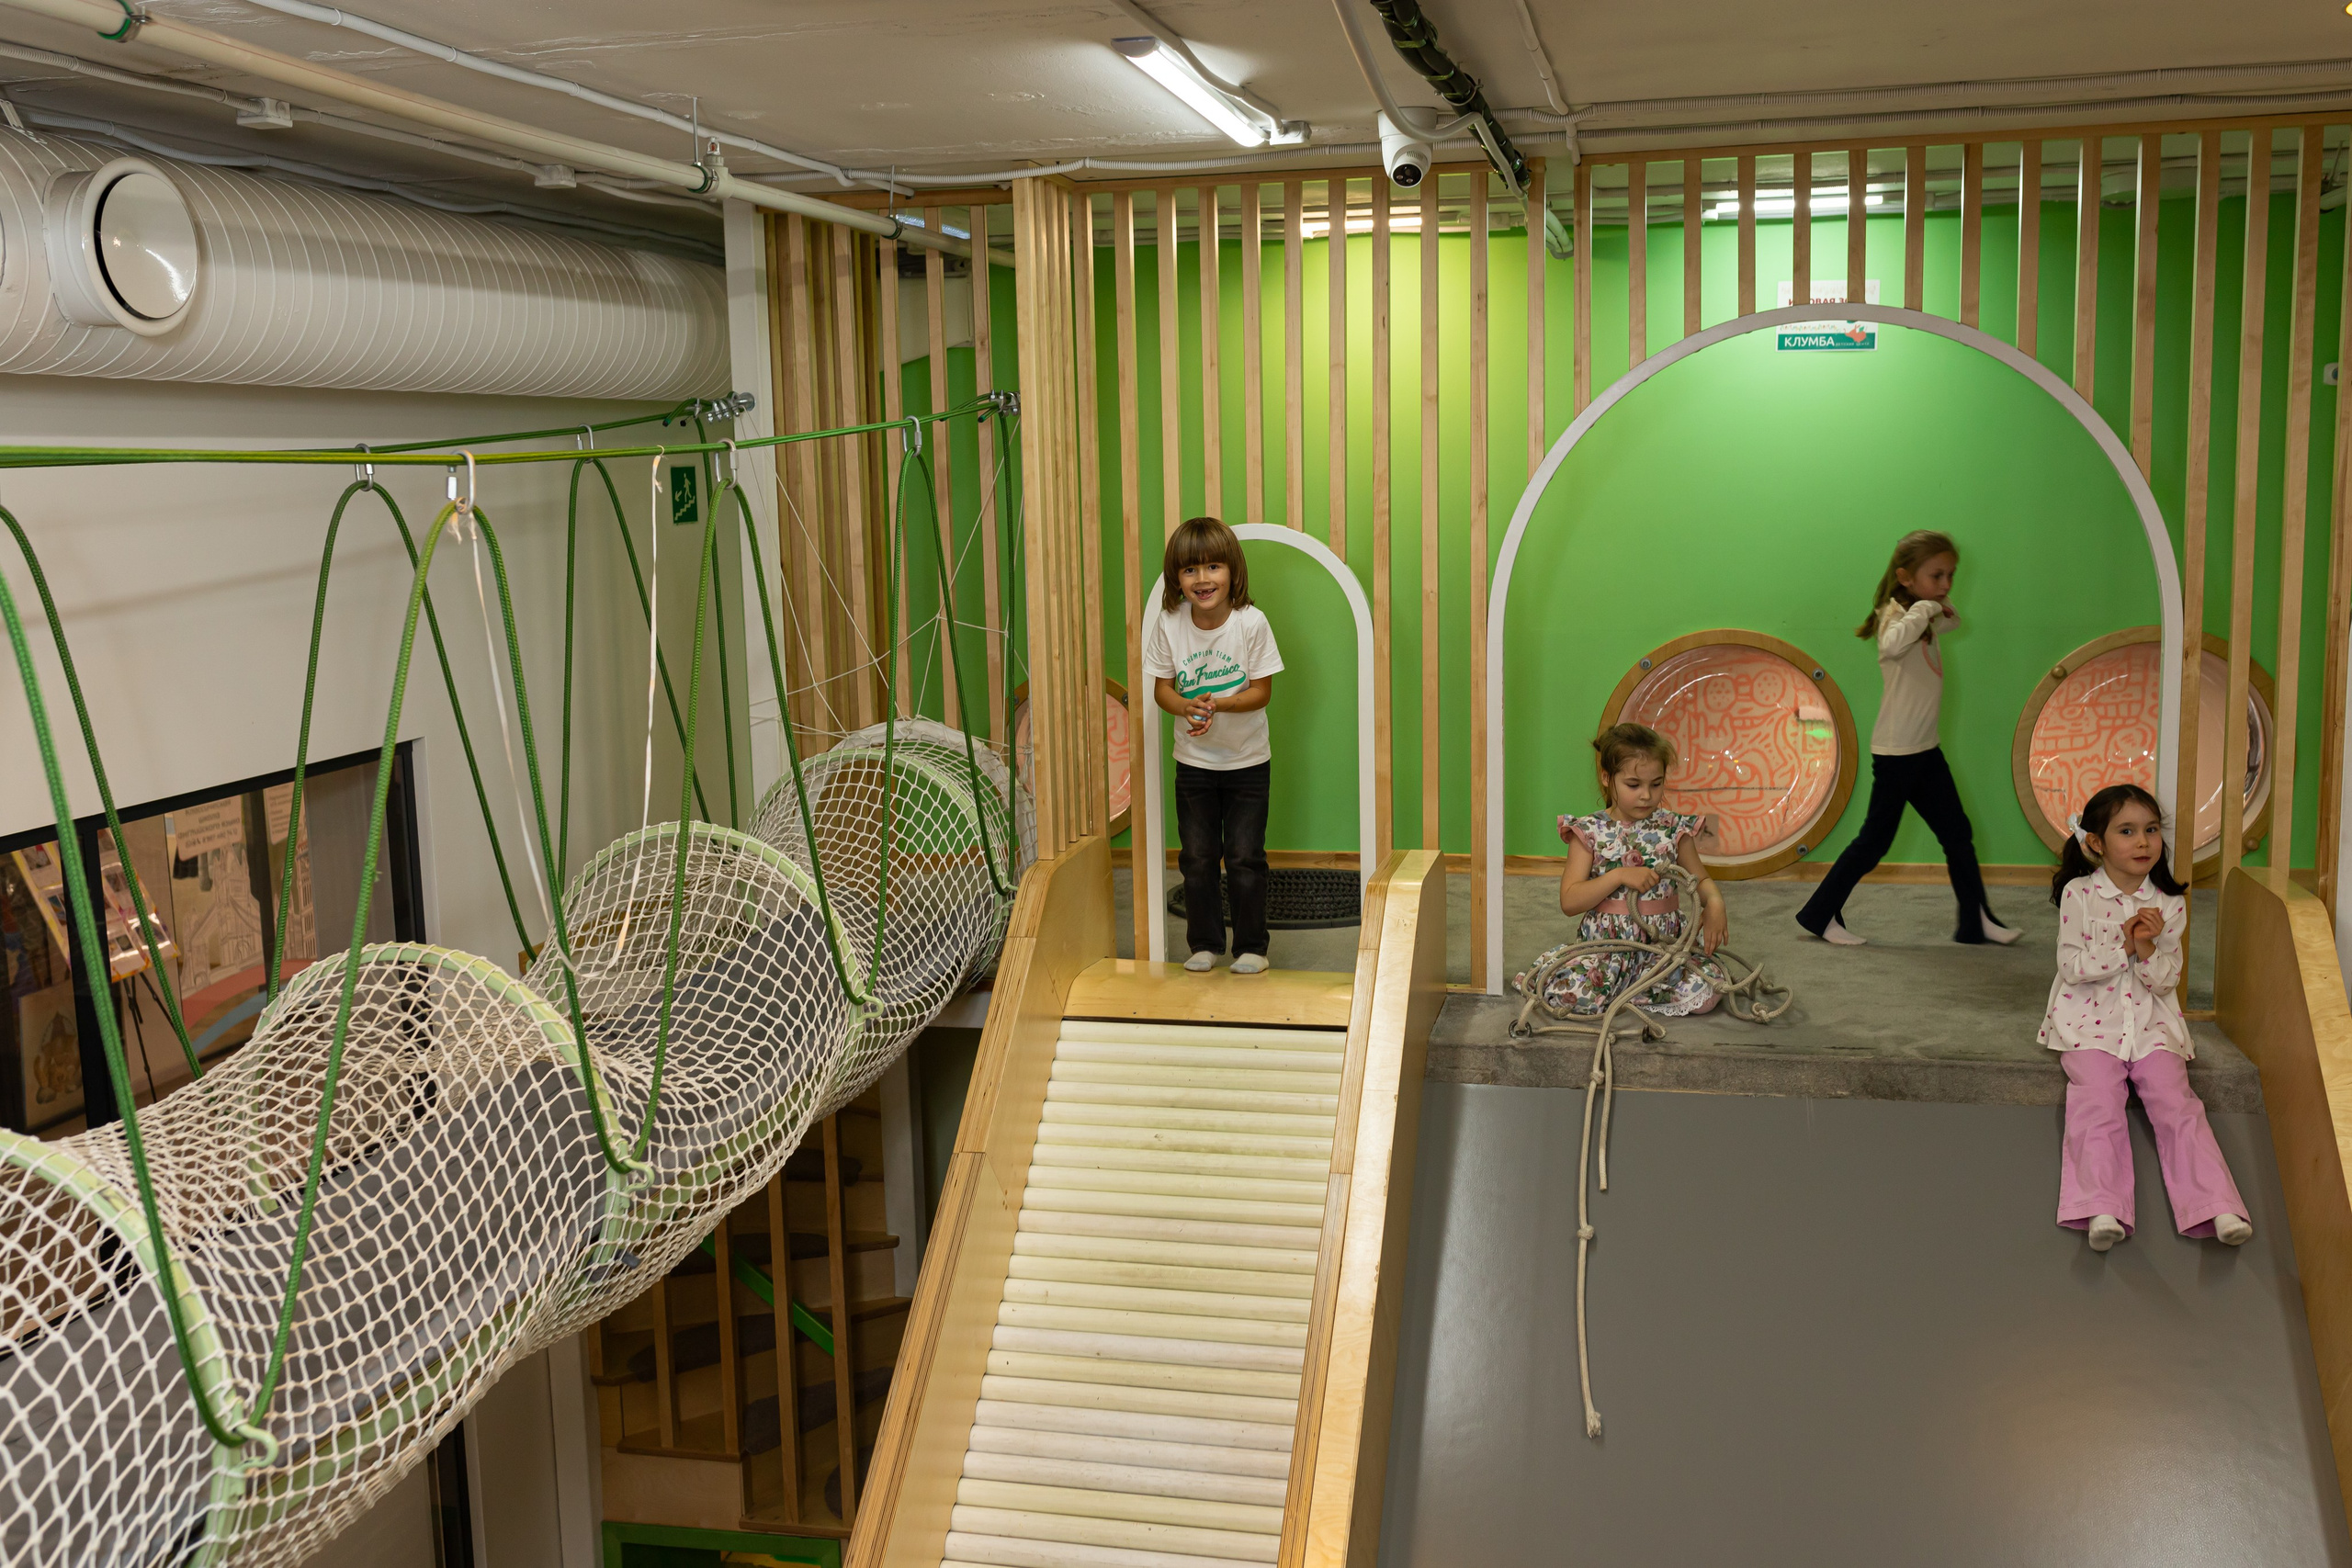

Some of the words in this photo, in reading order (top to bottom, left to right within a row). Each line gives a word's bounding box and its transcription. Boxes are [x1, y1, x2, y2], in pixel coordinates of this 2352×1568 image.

[1784, 336, 1835, 347] КЛУМБА
[1182, 649, 1213, 666] CHAMPION
[1216, 650, 1232, 663] TEAM
[1177, 671, 1196, 692] San
[1195, 663, 1240, 685] Francisco
